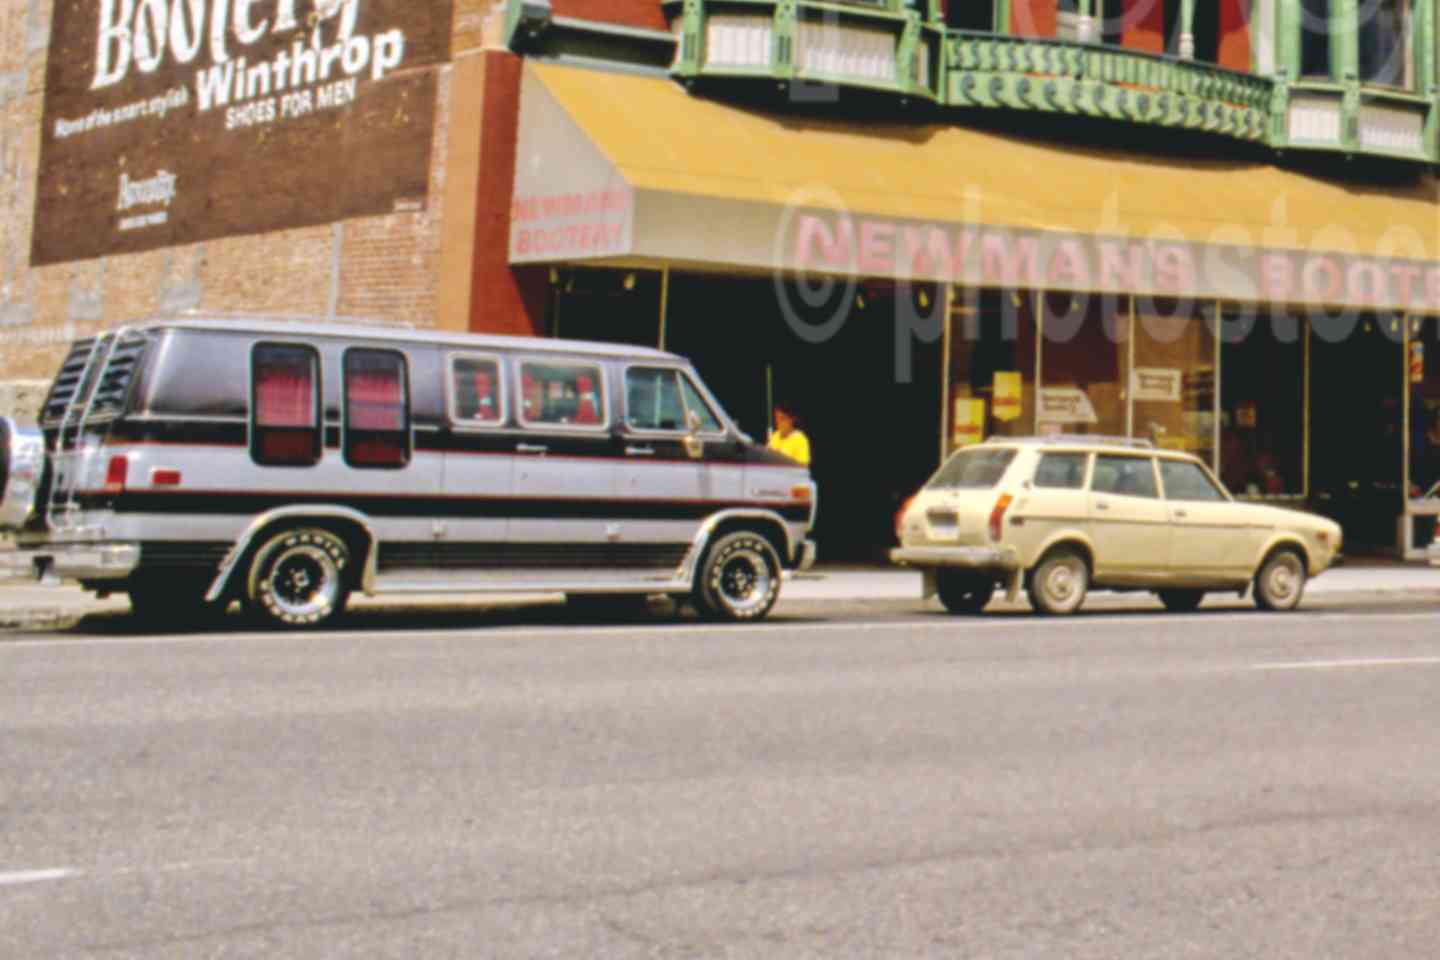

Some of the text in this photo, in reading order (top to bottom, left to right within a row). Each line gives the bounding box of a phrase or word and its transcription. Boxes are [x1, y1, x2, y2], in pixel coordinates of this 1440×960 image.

[195, 27, 405, 112] Winthrop
[225, 79, 358, 131] SHOES FOR MEN
